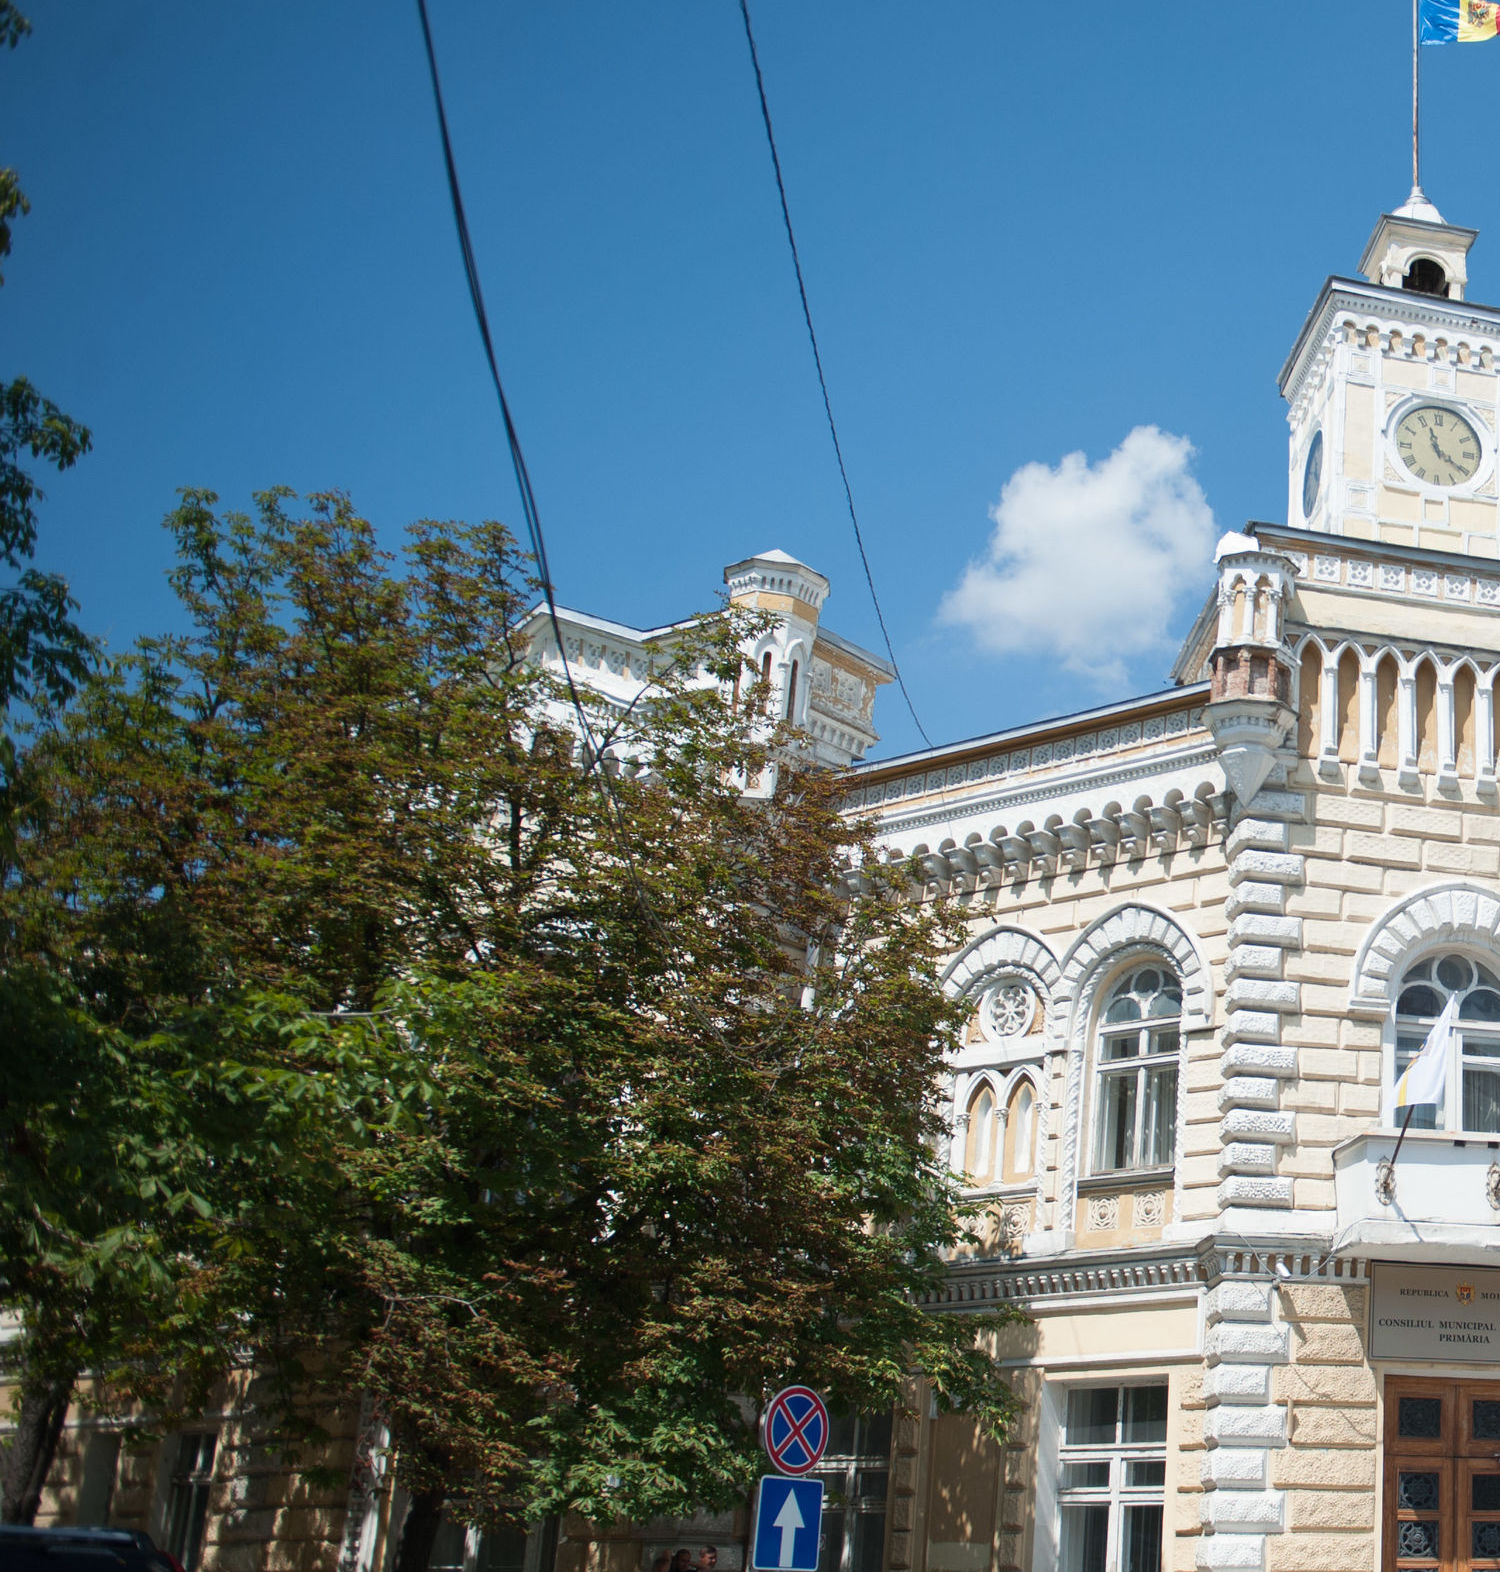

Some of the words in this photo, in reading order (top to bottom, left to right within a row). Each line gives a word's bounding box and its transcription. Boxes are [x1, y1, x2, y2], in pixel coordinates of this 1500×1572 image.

[1400, 1288, 1449, 1298] REPUBLICA
[1378, 1318, 1434, 1329] CONSILIUL
[1439, 1320, 1496, 1331] MUNICIPAL
